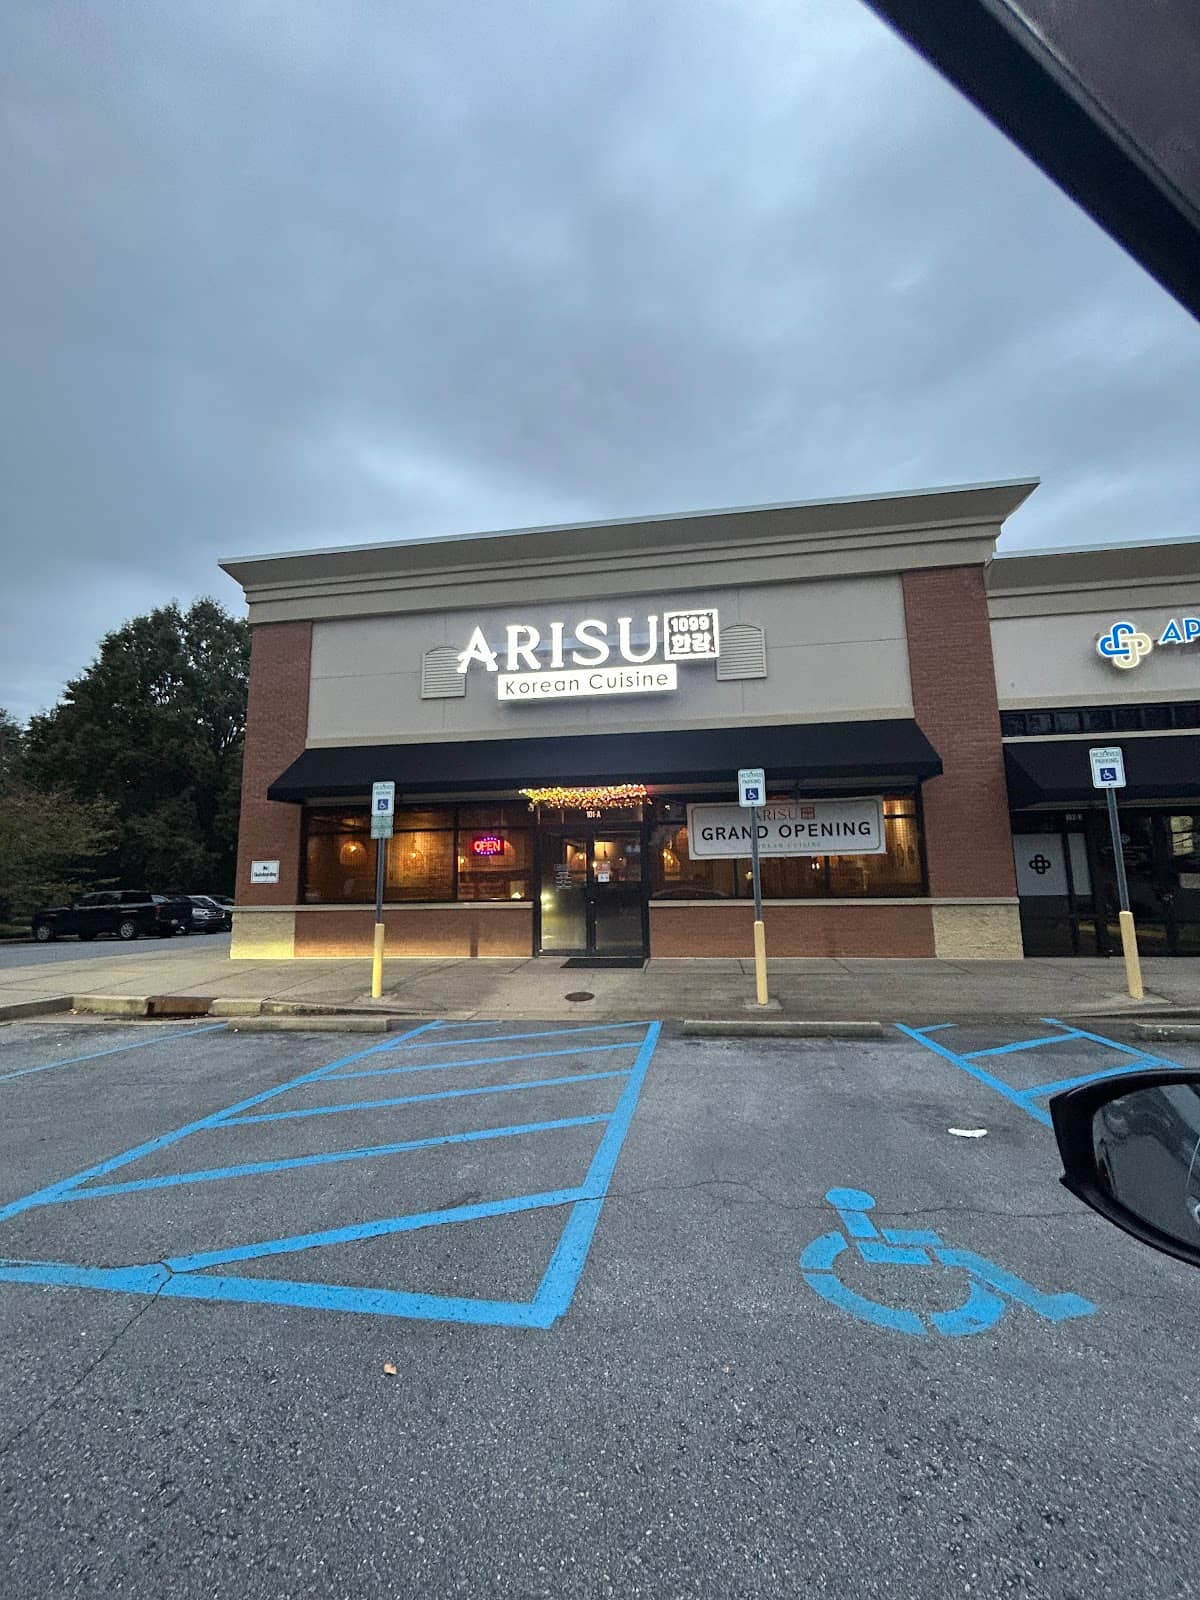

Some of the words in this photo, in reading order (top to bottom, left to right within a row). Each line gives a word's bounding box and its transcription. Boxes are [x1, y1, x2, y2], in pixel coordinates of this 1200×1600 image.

[670, 615, 710, 632] 1099
[1158, 618, 1200, 644] AP
[457, 616, 658, 673] ARISU
[505, 679, 579, 695] Korean
[589, 672, 669, 690] Cuisine
[701, 825, 769, 841] GRAND
[778, 821, 871, 838] OPENING
[474, 839, 501, 852] OPEN
